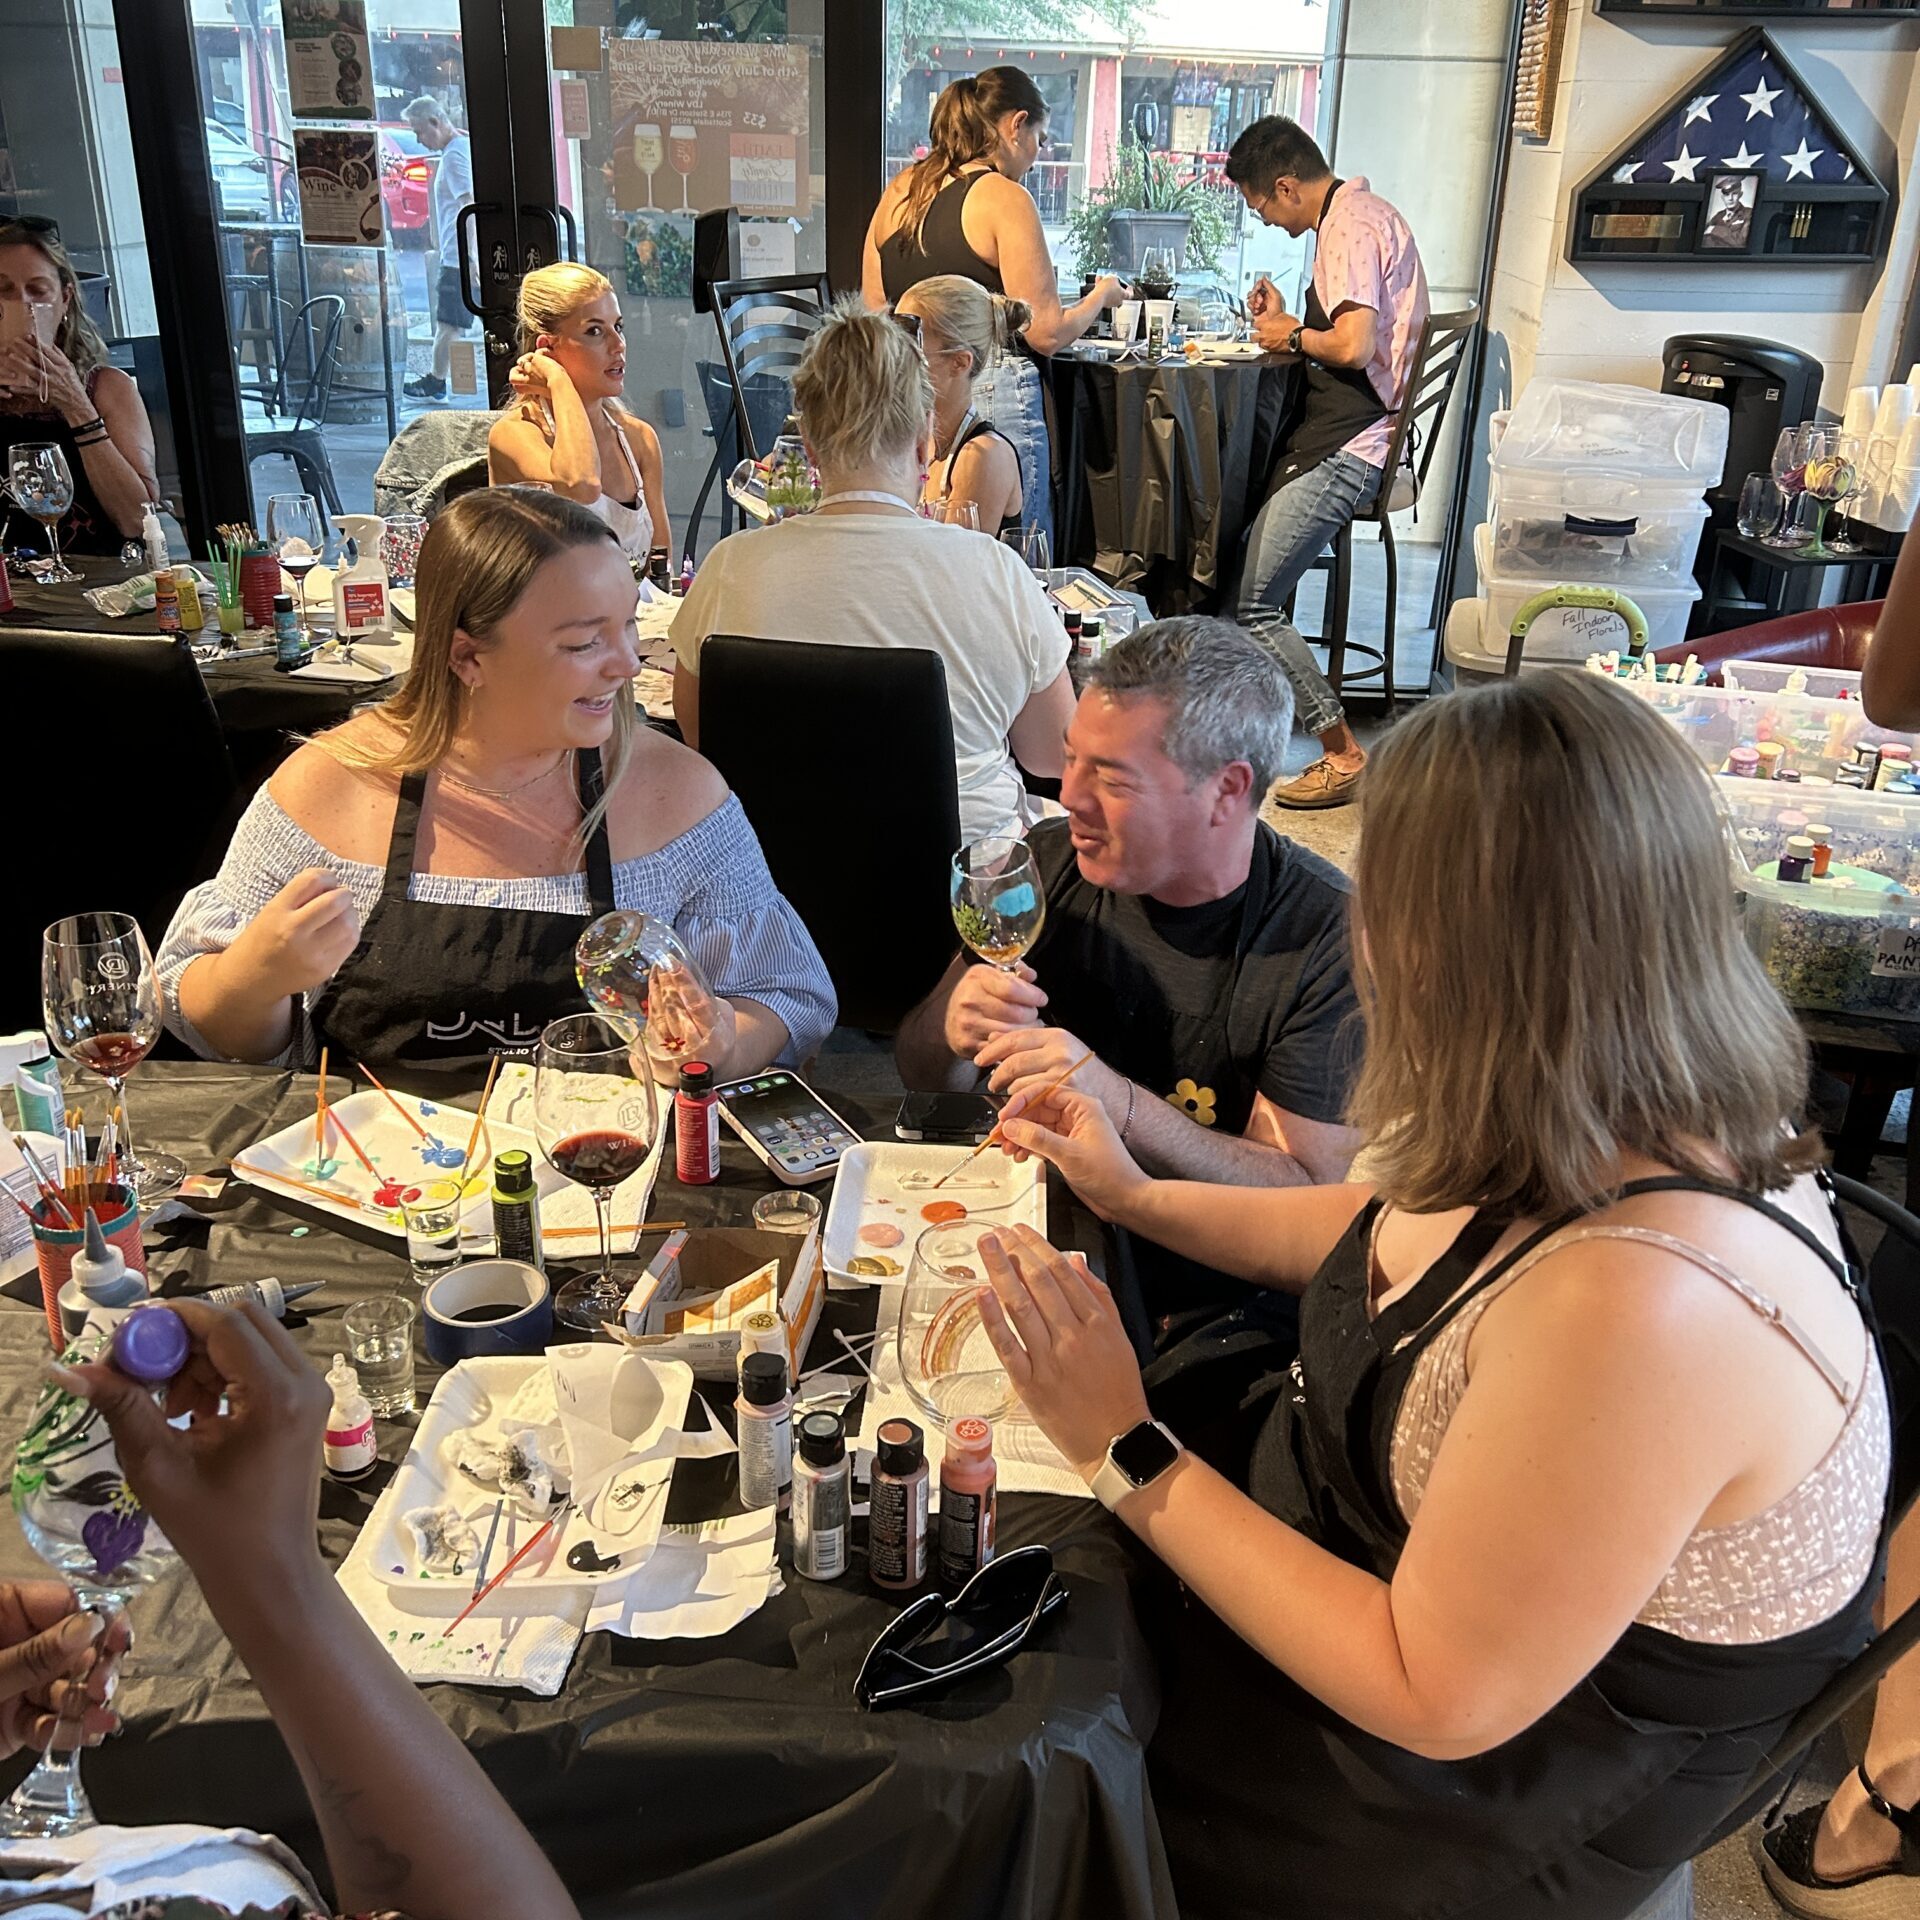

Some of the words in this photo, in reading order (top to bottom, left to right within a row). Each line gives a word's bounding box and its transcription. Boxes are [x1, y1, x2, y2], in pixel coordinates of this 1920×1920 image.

[302, 179, 337, 192] Wine
[493, 271, 510, 281] PUSH
[1562, 608, 1585, 626] Fall
[1572, 614, 1614, 634] Indoor
